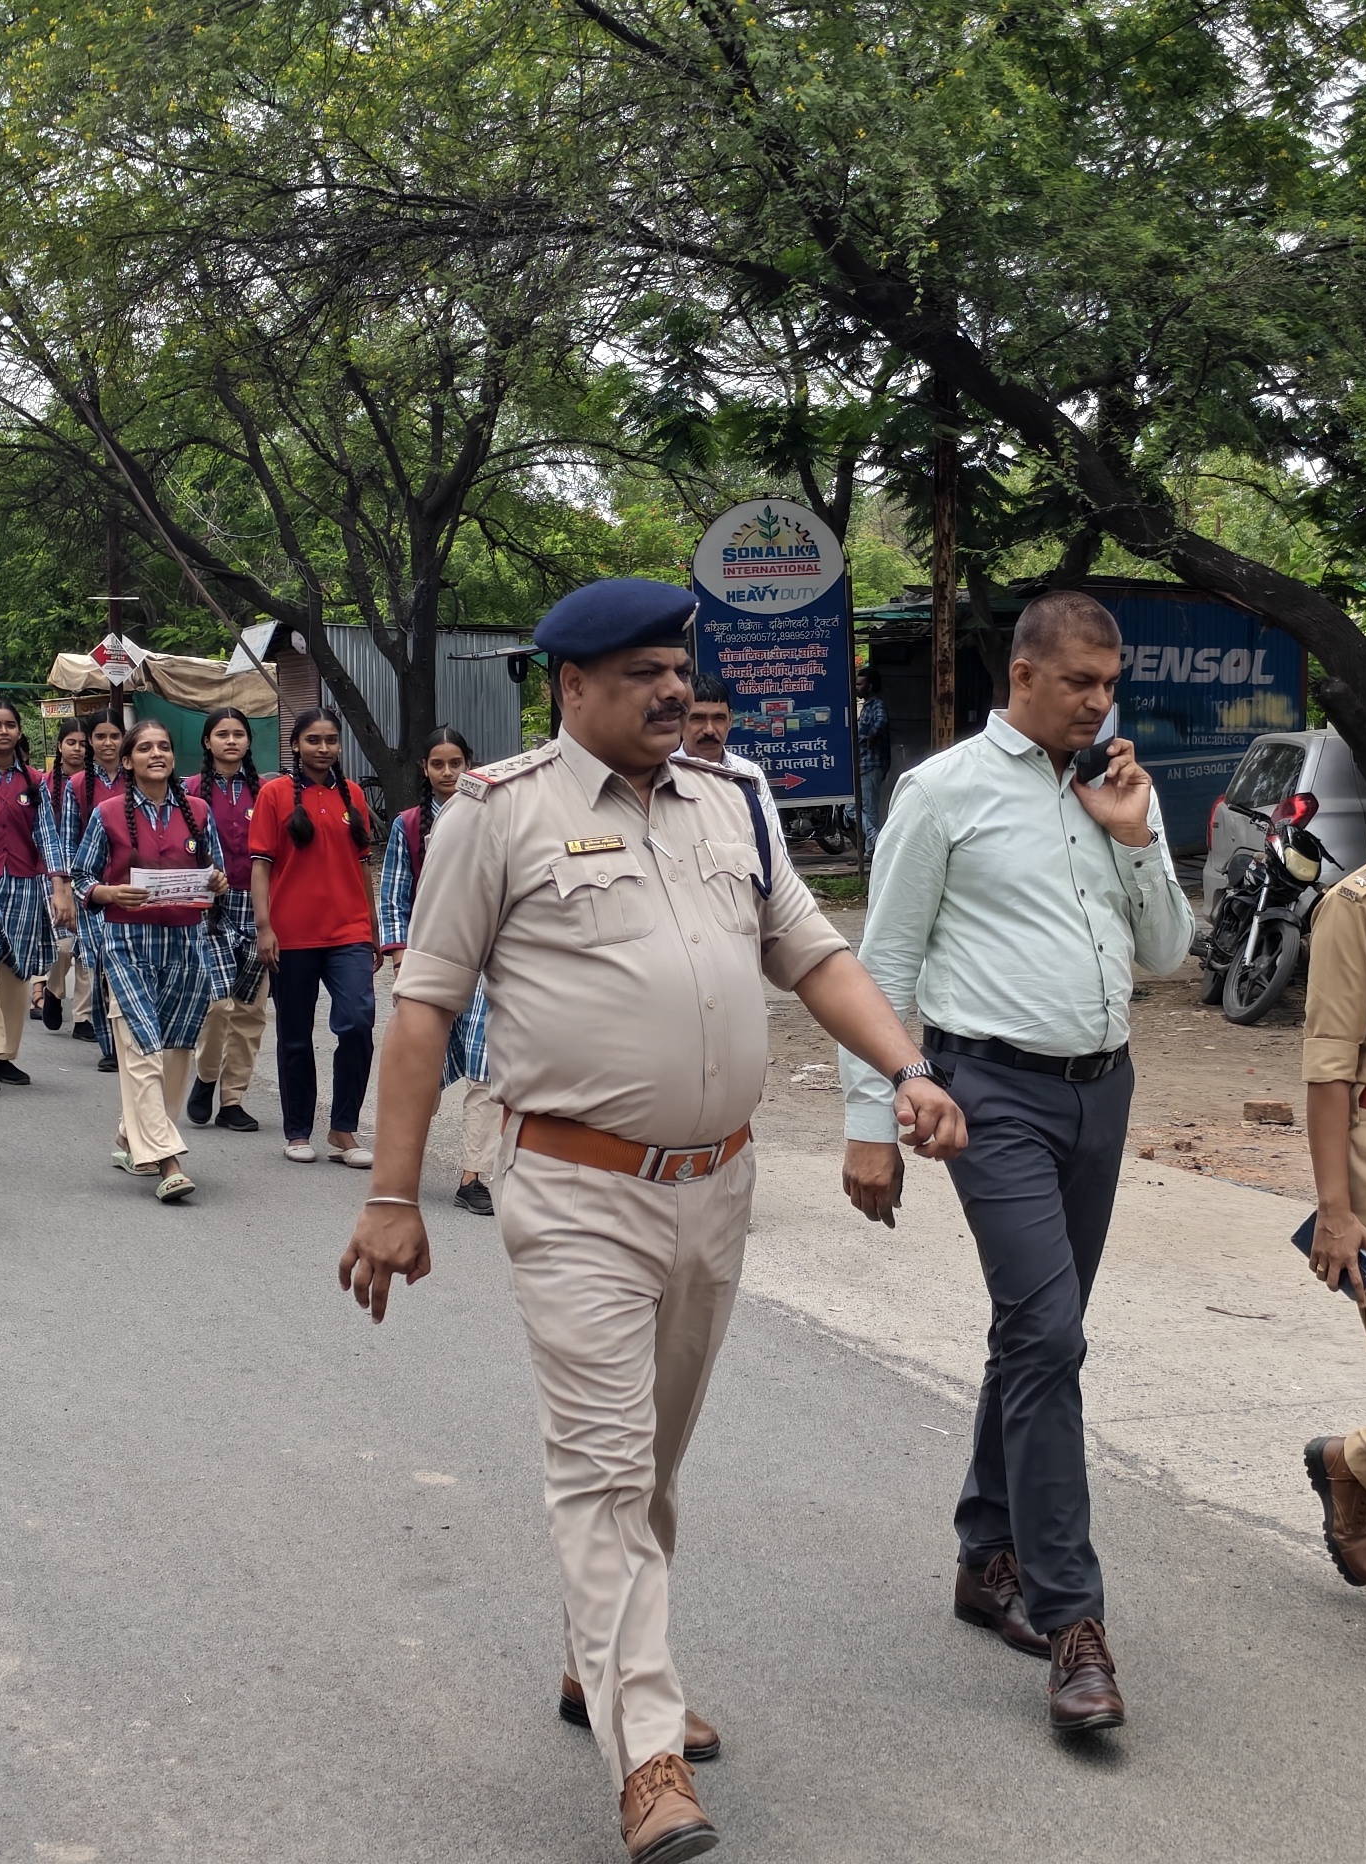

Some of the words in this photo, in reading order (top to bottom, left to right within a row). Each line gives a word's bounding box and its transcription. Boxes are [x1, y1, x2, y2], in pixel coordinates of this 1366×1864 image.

[722, 545, 820, 562] SONALIKA
[723, 564, 821, 576] INTERNATIONAL
[726, 588, 779, 603] HEAVY
[780, 587, 820, 600] DUTY
[1118, 645, 1275, 684] PENSOL
[775, 757, 819, 770] उपलब्ध
